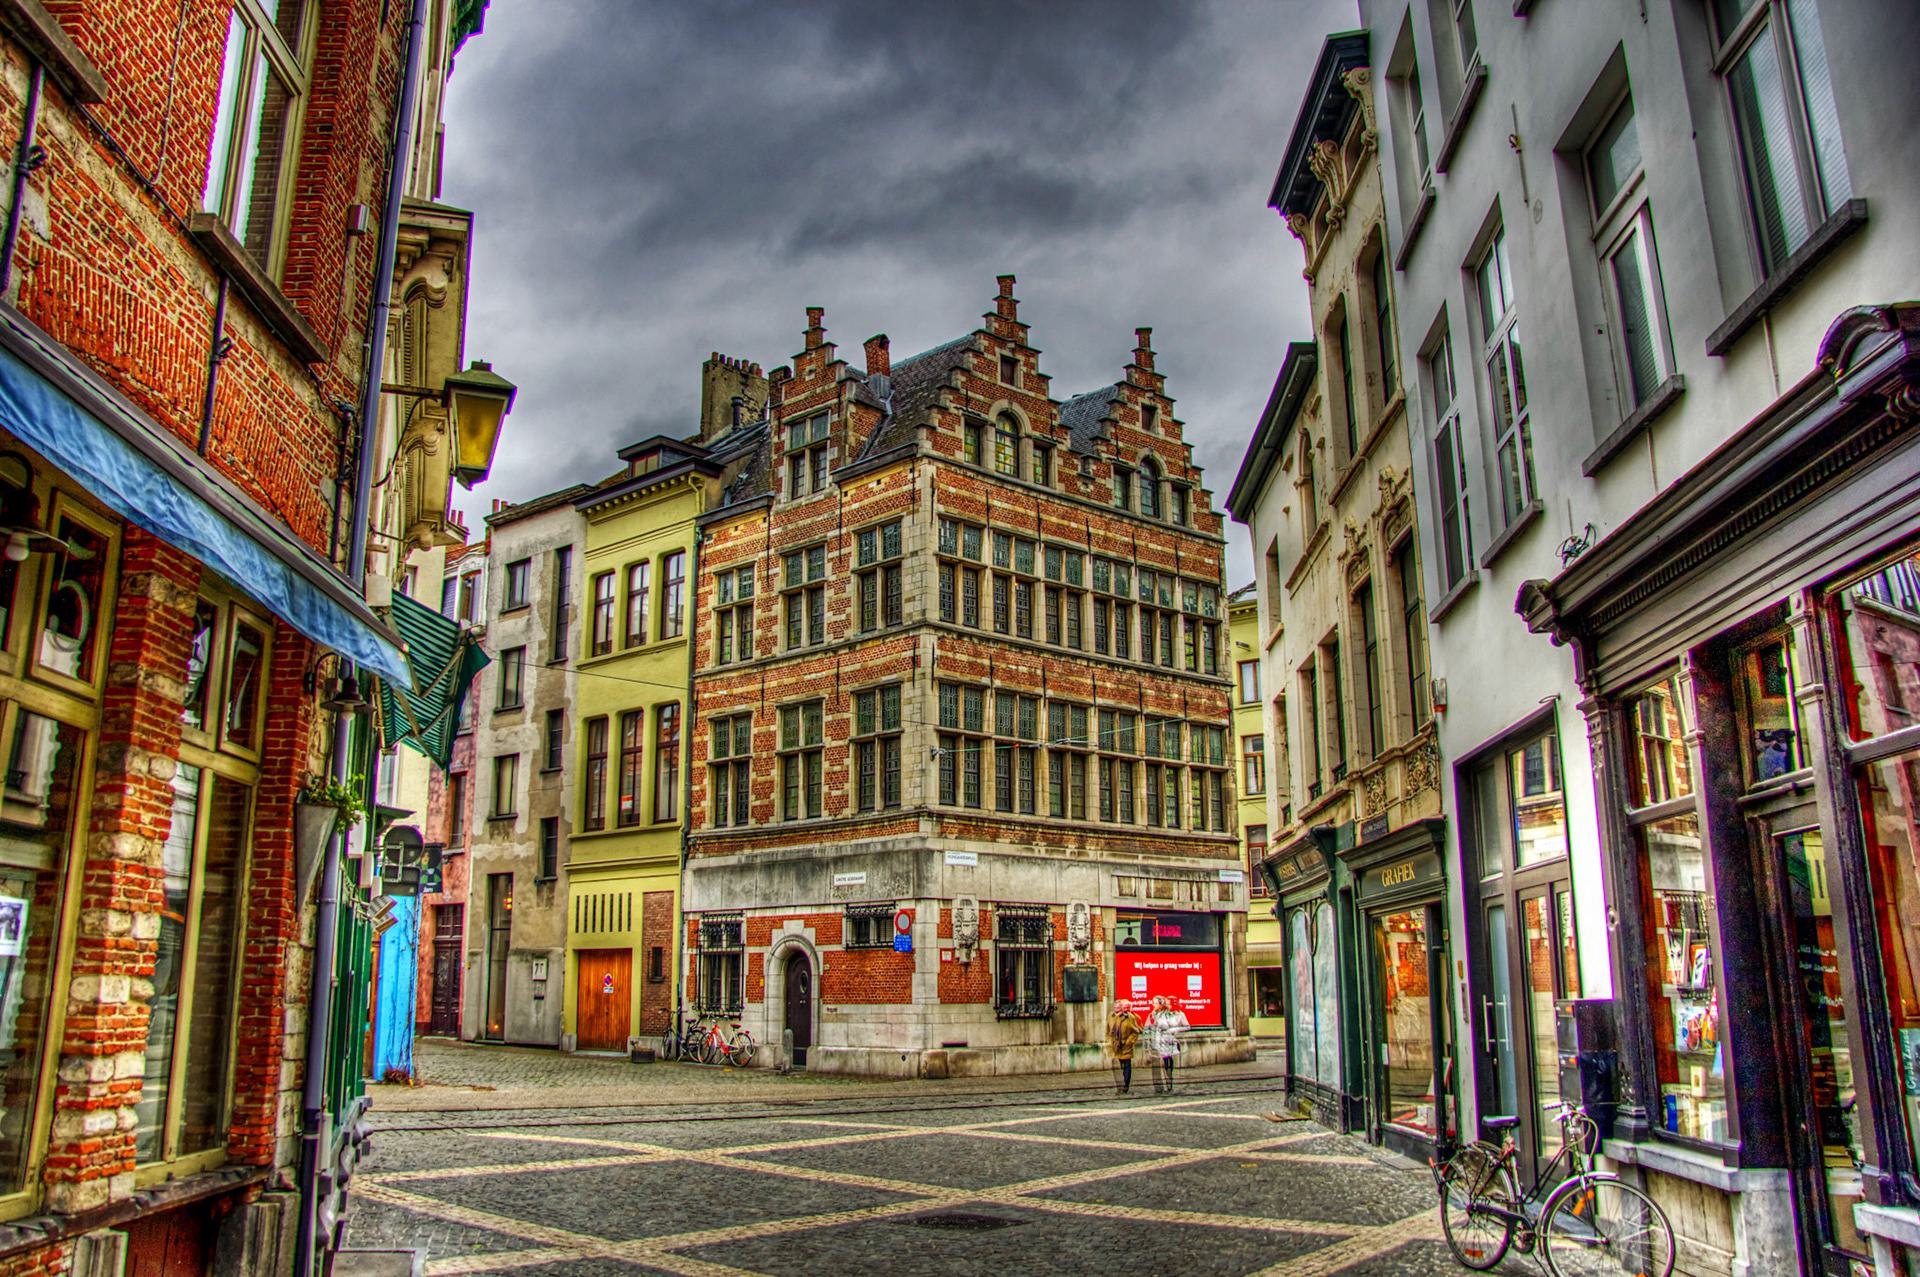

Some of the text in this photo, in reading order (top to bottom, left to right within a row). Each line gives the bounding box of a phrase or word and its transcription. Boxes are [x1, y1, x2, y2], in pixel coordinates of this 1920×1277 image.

[1381, 862, 1416, 887] GRAFIEK
[1134, 962, 1142, 970] Wij
[1143, 962, 1159, 970] helpen
